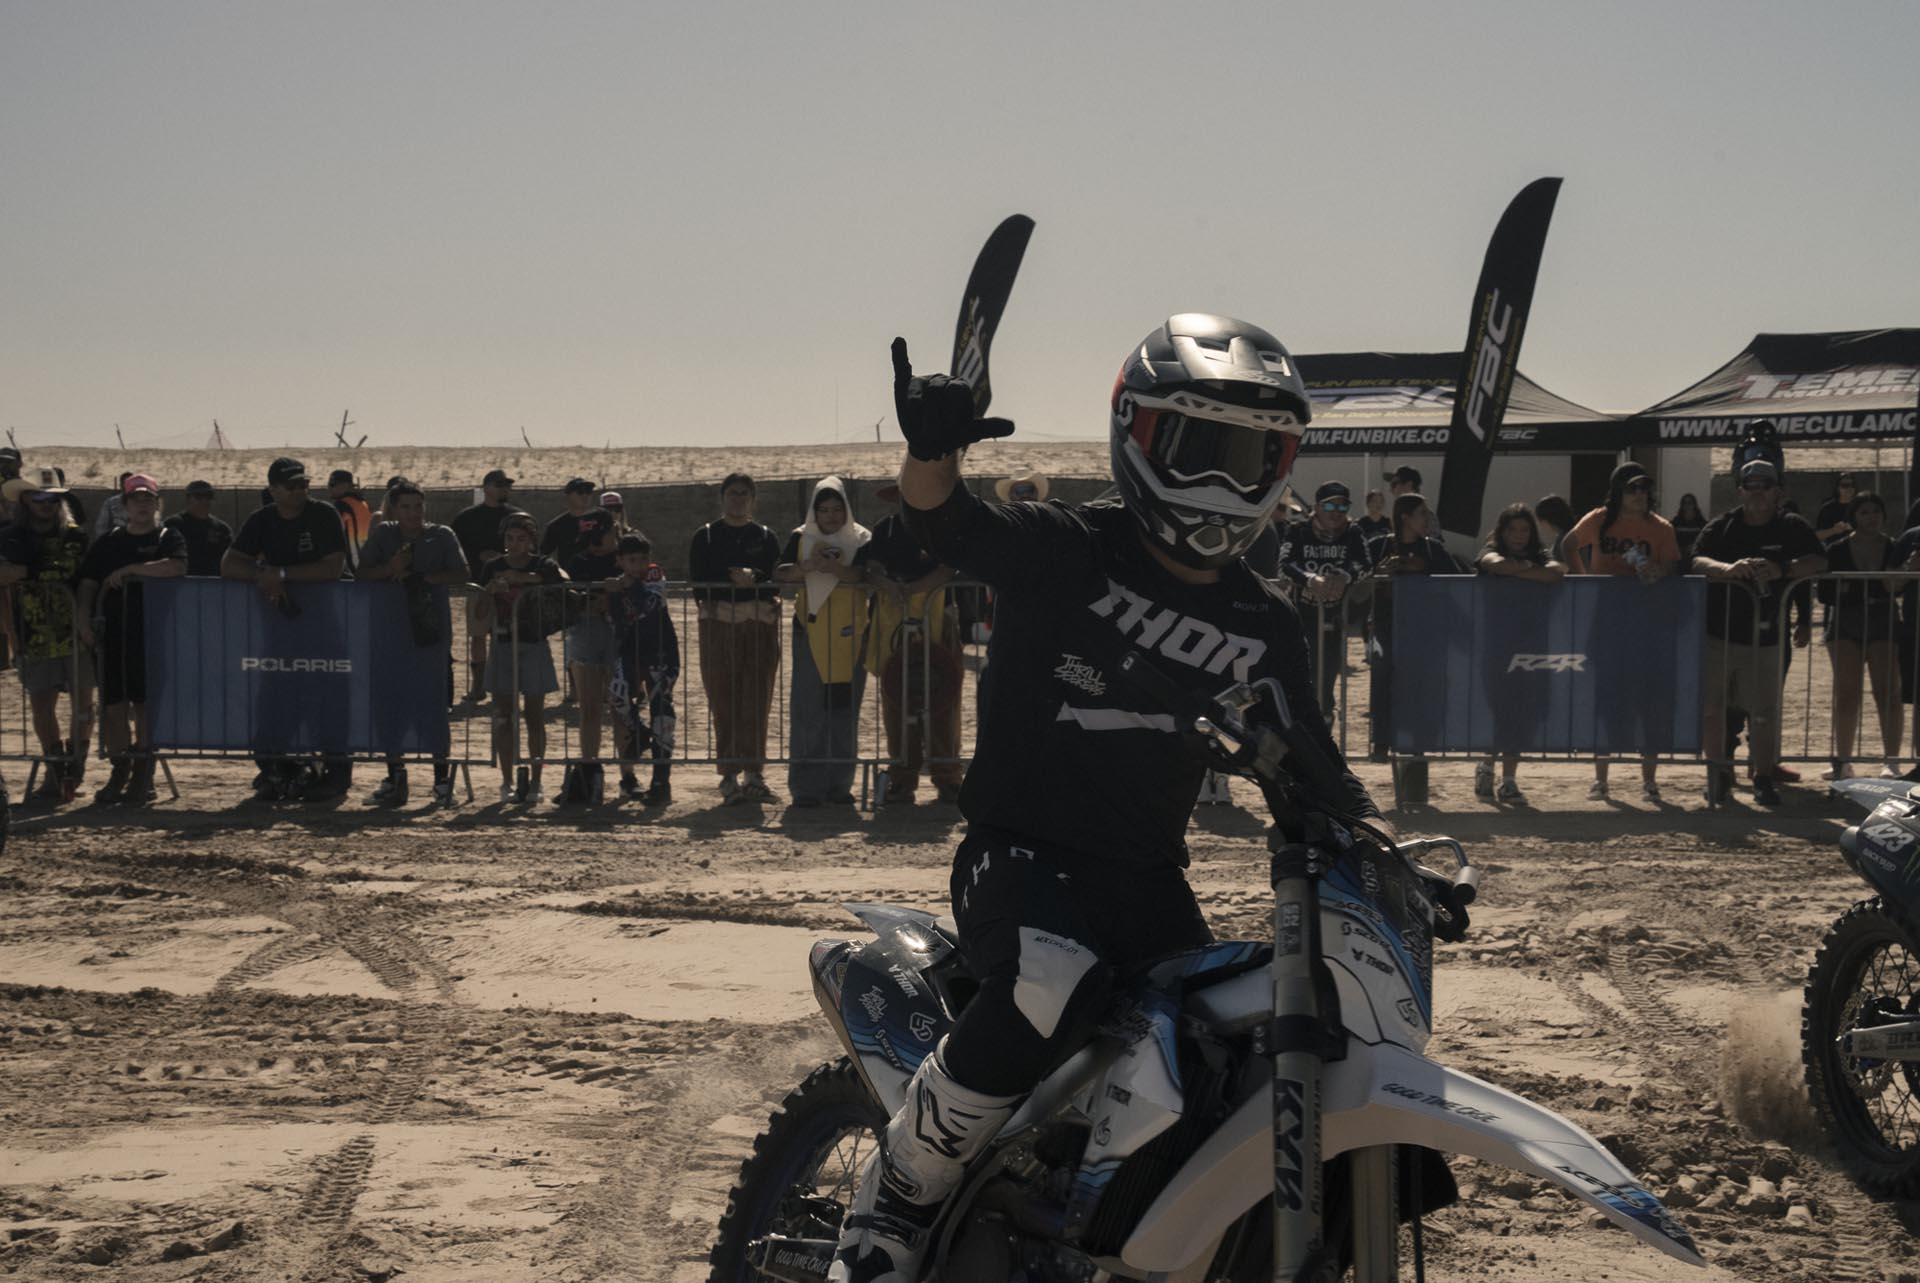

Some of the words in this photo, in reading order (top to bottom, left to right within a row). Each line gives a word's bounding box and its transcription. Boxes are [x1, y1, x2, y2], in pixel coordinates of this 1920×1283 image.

[1466, 288, 1512, 442] FBC
[1658, 412, 1918, 439] WWW.TMECULAMO
[1088, 576, 1268, 684] THOR
[241, 657, 352, 673] POLARIS
[1507, 653, 1587, 673] RZR
[1863, 823, 1915, 852] 423
[893, 970, 919, 999] THOR
[1274, 1079, 1304, 1211] KYB
